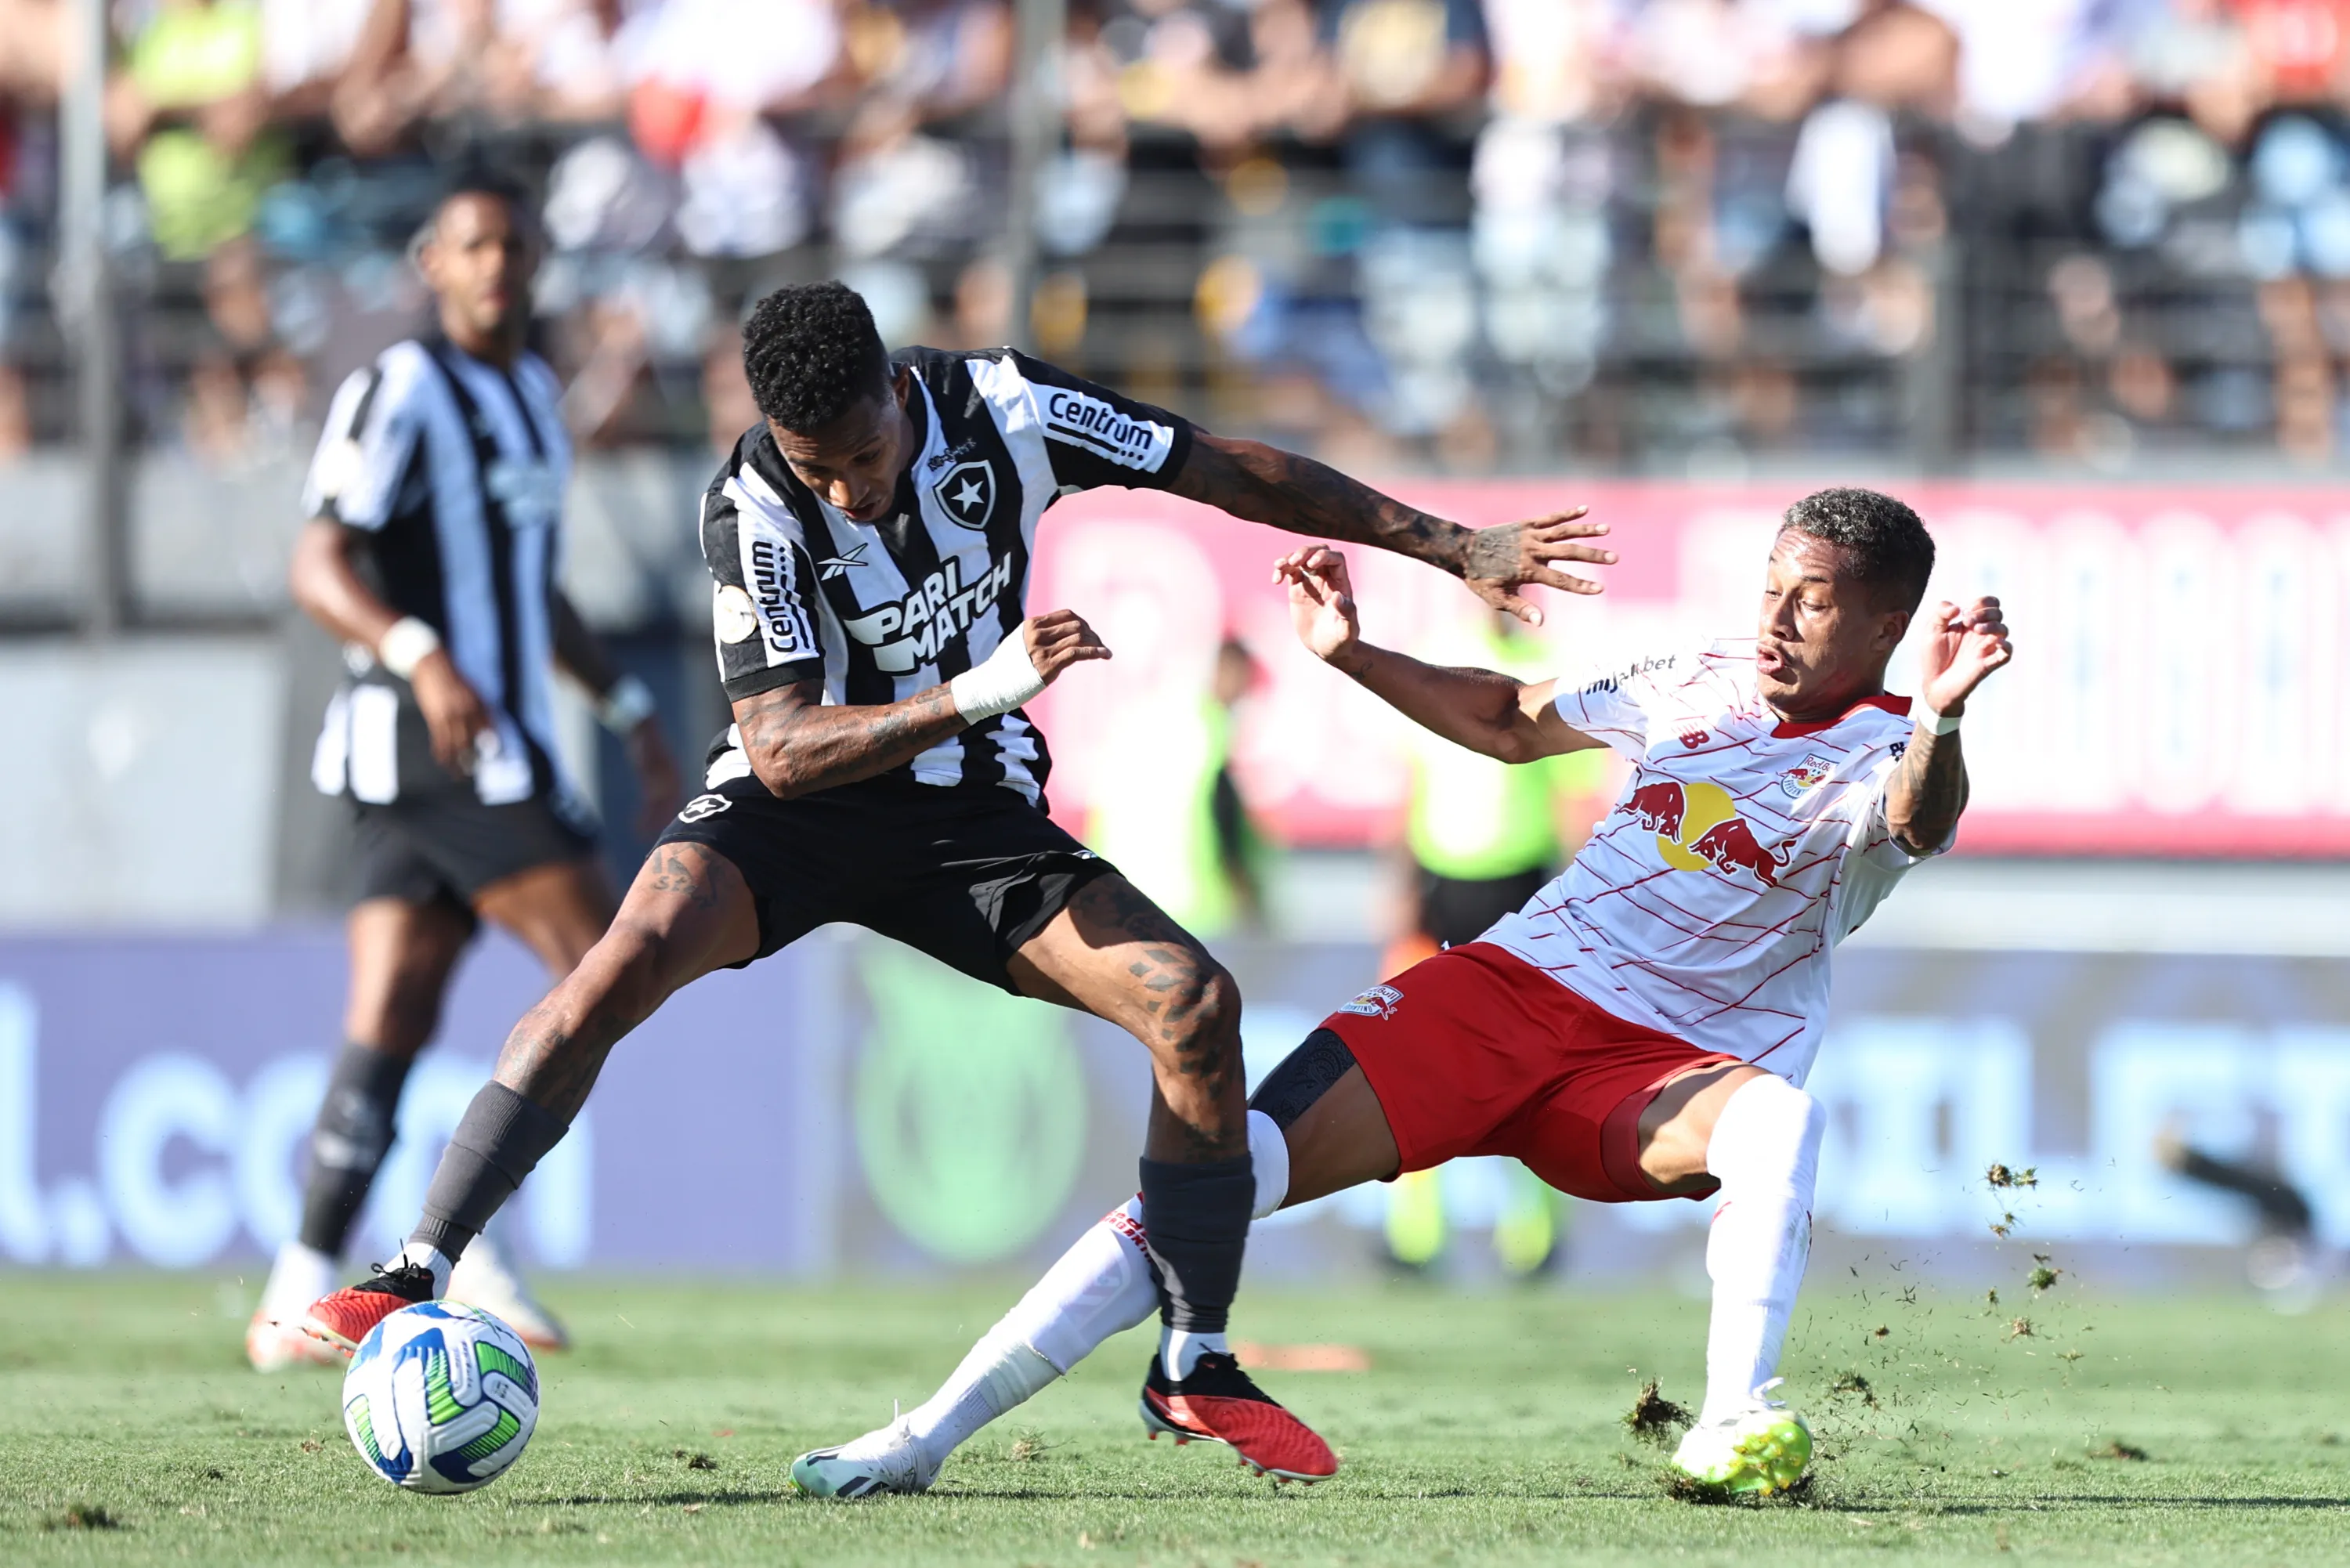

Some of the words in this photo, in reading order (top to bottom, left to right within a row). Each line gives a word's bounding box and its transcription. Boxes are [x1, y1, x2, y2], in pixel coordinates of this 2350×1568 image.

[1049, 392, 1153, 450] Centrum
[752, 540, 798, 653] Centrum
[843, 561, 958, 645] PARI
[873, 551, 1012, 672] MATCH
